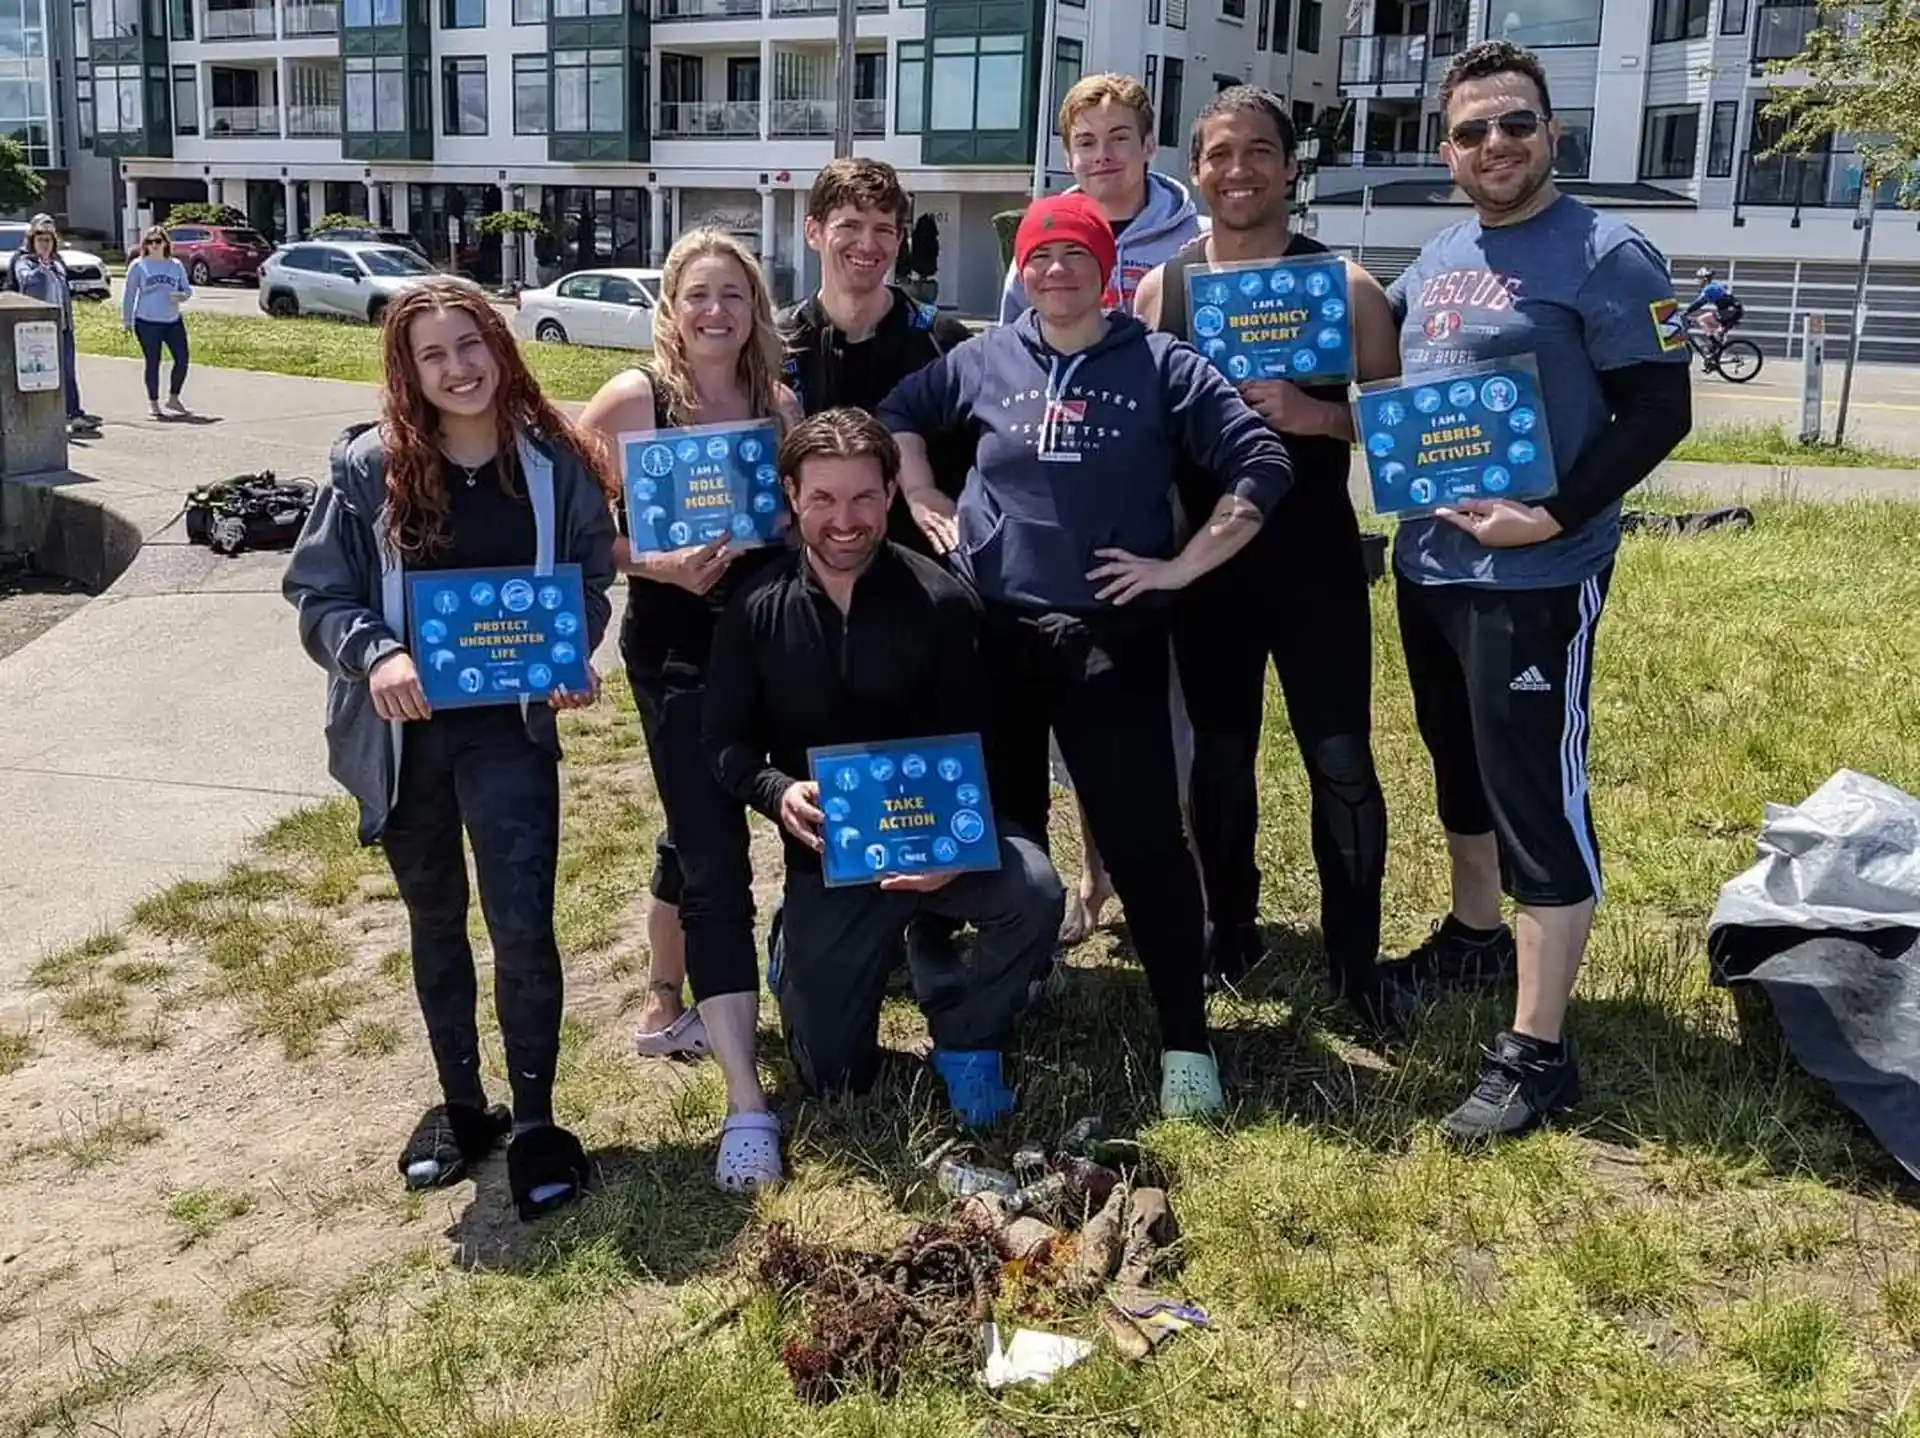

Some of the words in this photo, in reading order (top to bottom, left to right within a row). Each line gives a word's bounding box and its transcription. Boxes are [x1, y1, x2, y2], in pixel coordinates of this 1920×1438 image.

[1258, 300, 1275, 309] AM
[1276, 299, 1284, 307] A
[1228, 310, 1309, 328] BUOYANCY
[1240, 327, 1301, 343] EXPERT
[1002, 386, 1137, 411] UNDWATER
[1439, 414, 1456, 426] AM
[1458, 412, 1467, 422] A
[1023, 424, 1105, 437] SRTS
[1421, 424, 1482, 446] DEBRIS
[1025, 439, 1100, 450] WANGTON
[1417, 441, 1492, 467] ACTIVIST
[697, 465, 712, 476] AM
[712, 464, 721, 473] A
[689, 477, 725, 492] ROLE
[685, 493, 732, 509] MODEL
[473, 620, 529, 632] PROTECT
[459, 634, 545, 647] UNDERWATER
[490, 648, 517, 659] LIFE
[1509, 681, 1551, 691] adidas
[883, 797, 926, 812] TAKE
[879, 813, 936, 831] ACTION
